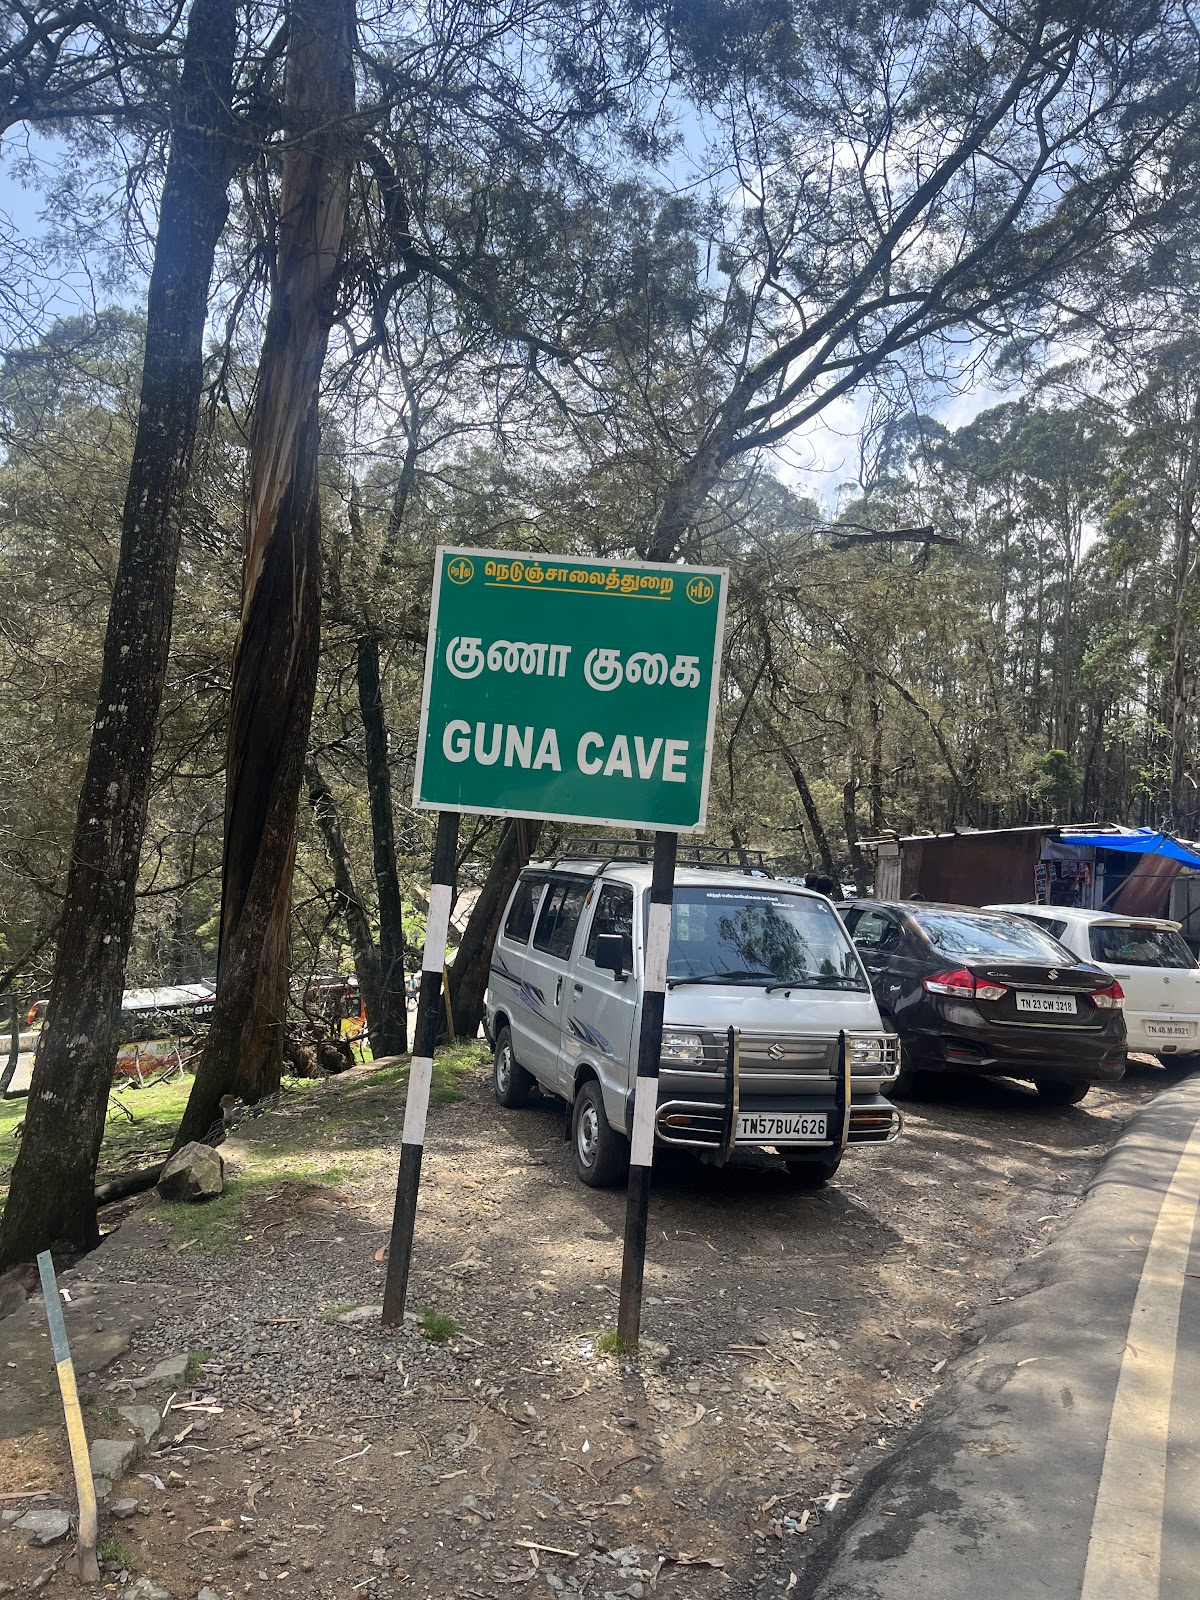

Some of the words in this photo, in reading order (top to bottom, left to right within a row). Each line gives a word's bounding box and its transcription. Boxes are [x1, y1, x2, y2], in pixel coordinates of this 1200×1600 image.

[484, 560, 674, 595] நெடுஞ்சாலைத்துறை
[445, 636, 572, 680] குணா
[583, 648, 701, 692] குகை
[443, 719, 562, 772] GUNA
[576, 731, 689, 783] CAVE
[1020, 999, 1031, 1009] TN
[1032, 999, 1041, 1009] 23
[1043, 1000, 1054, 1010] CW
[1055, 1001, 1072, 1012] 3218
[741, 1118, 825, 1135] TN57BU4626
